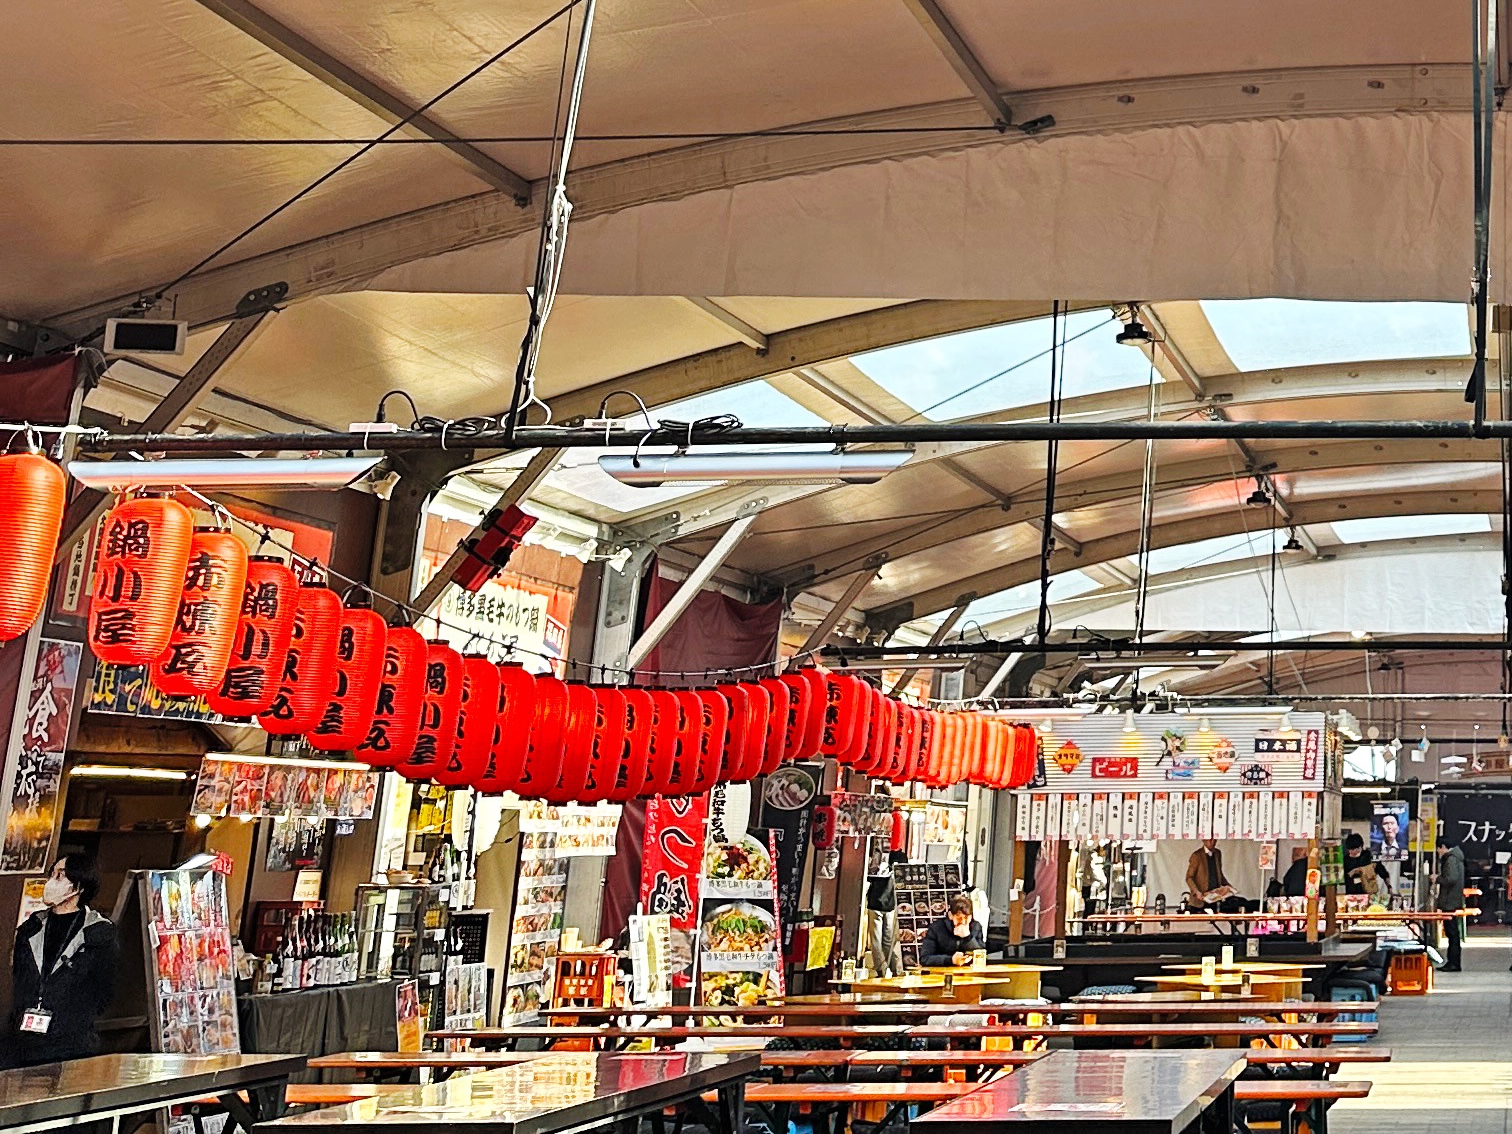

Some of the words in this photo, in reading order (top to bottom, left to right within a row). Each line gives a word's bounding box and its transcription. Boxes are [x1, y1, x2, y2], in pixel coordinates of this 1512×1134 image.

[92, 518, 150, 645] 鍋小屋
[161, 550, 228, 676] 赤煉瓦
[219, 580, 279, 701] 鍋小屋
[1095, 761, 1135, 777] ビール
[1258, 739, 1298, 751] 日本酒
